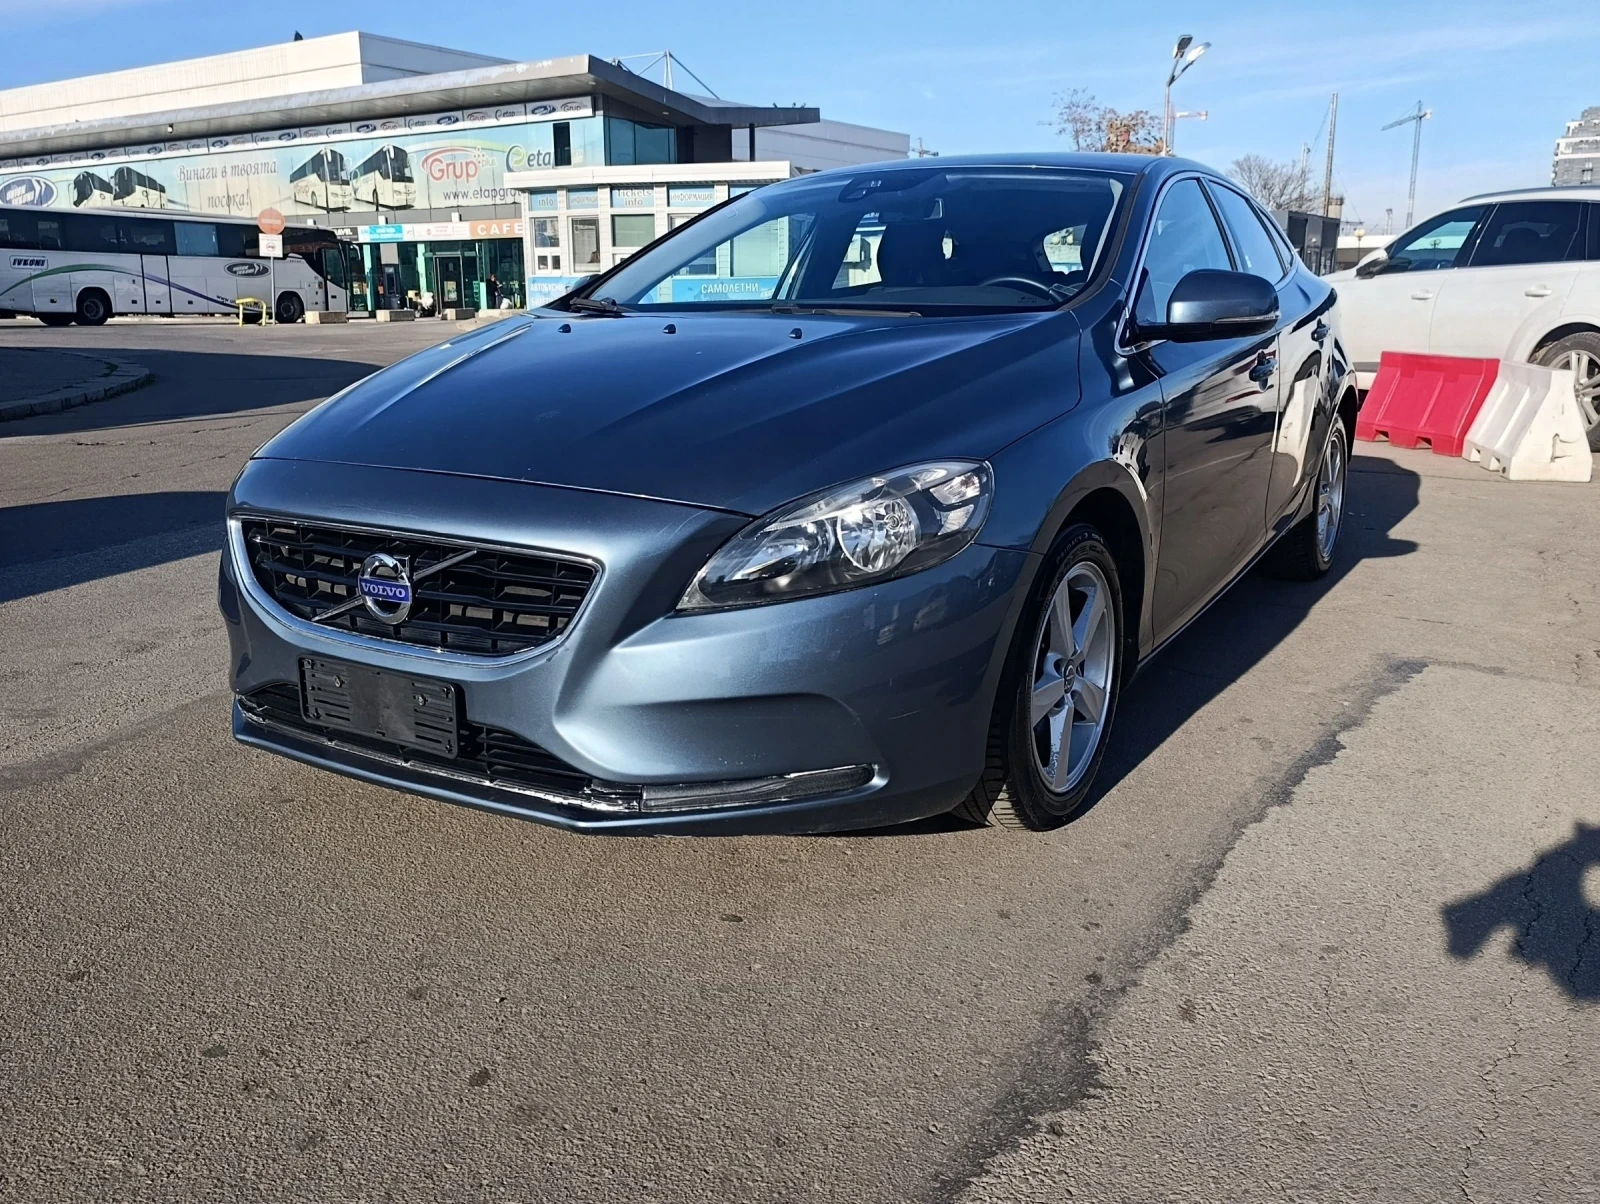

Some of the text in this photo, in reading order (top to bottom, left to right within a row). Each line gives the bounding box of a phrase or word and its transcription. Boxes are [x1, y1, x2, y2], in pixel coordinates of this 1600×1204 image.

[527, 150, 555, 168] eta
[178, 161, 277, 181] Винаги в твоята
[429, 158, 479, 184] Grup
[208, 188, 249, 210] посока!
[624, 198, 643, 207] info
[670, 192, 713, 202] ИНФОРМАЦИЯ
[477, 222, 524, 236] CAFE
[701, 282, 759, 294] САМОЛЕТНИ
[361, 582, 406, 598] VOLVO
